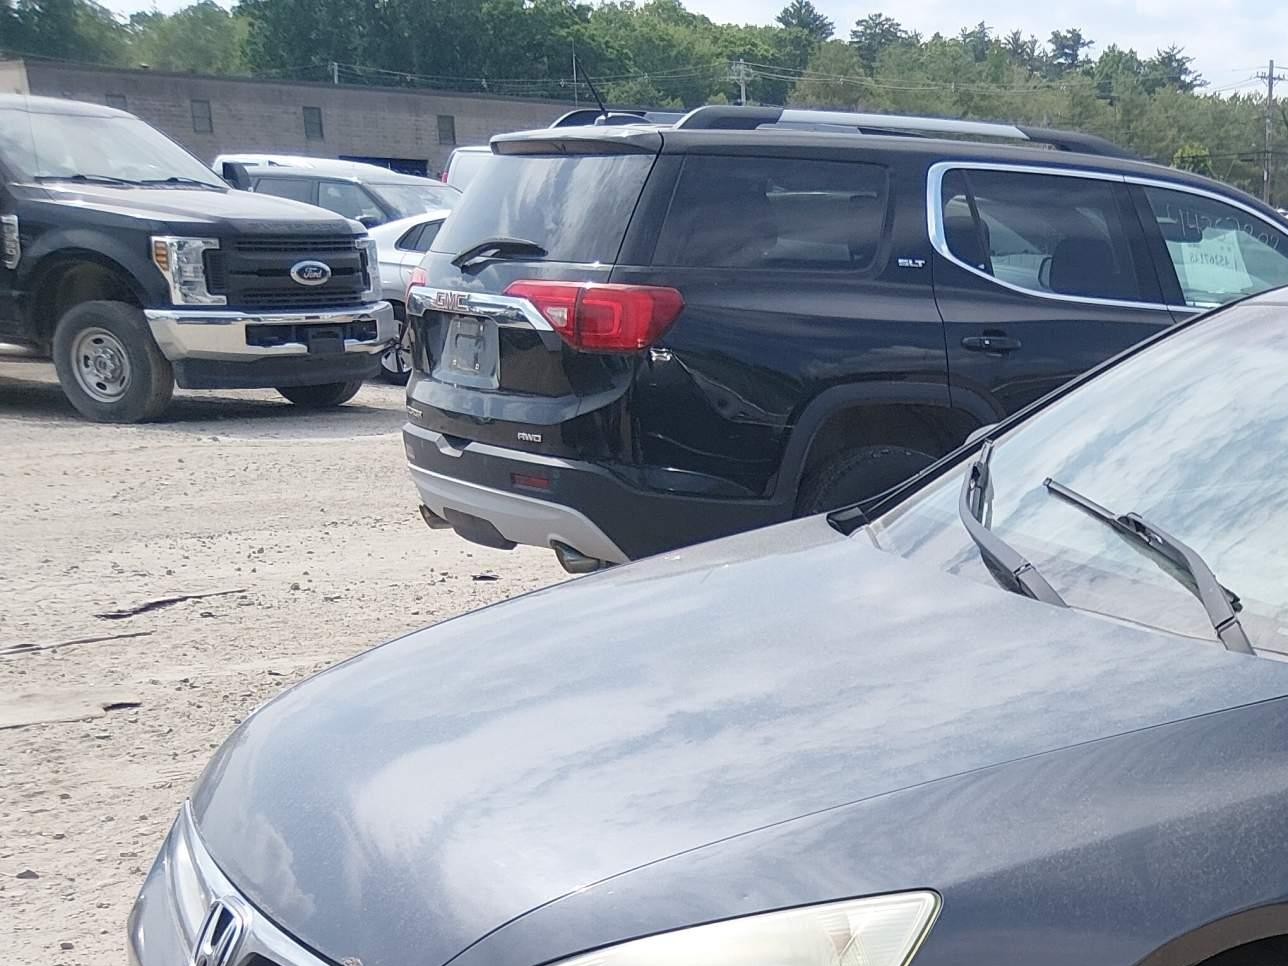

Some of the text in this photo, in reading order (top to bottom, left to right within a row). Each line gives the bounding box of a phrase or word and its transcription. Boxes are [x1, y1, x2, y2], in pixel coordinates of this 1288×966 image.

[898, 259, 926, 268] SLT
[434, 291, 469, 312] GMC
[517, 432, 542, 443] AWD
